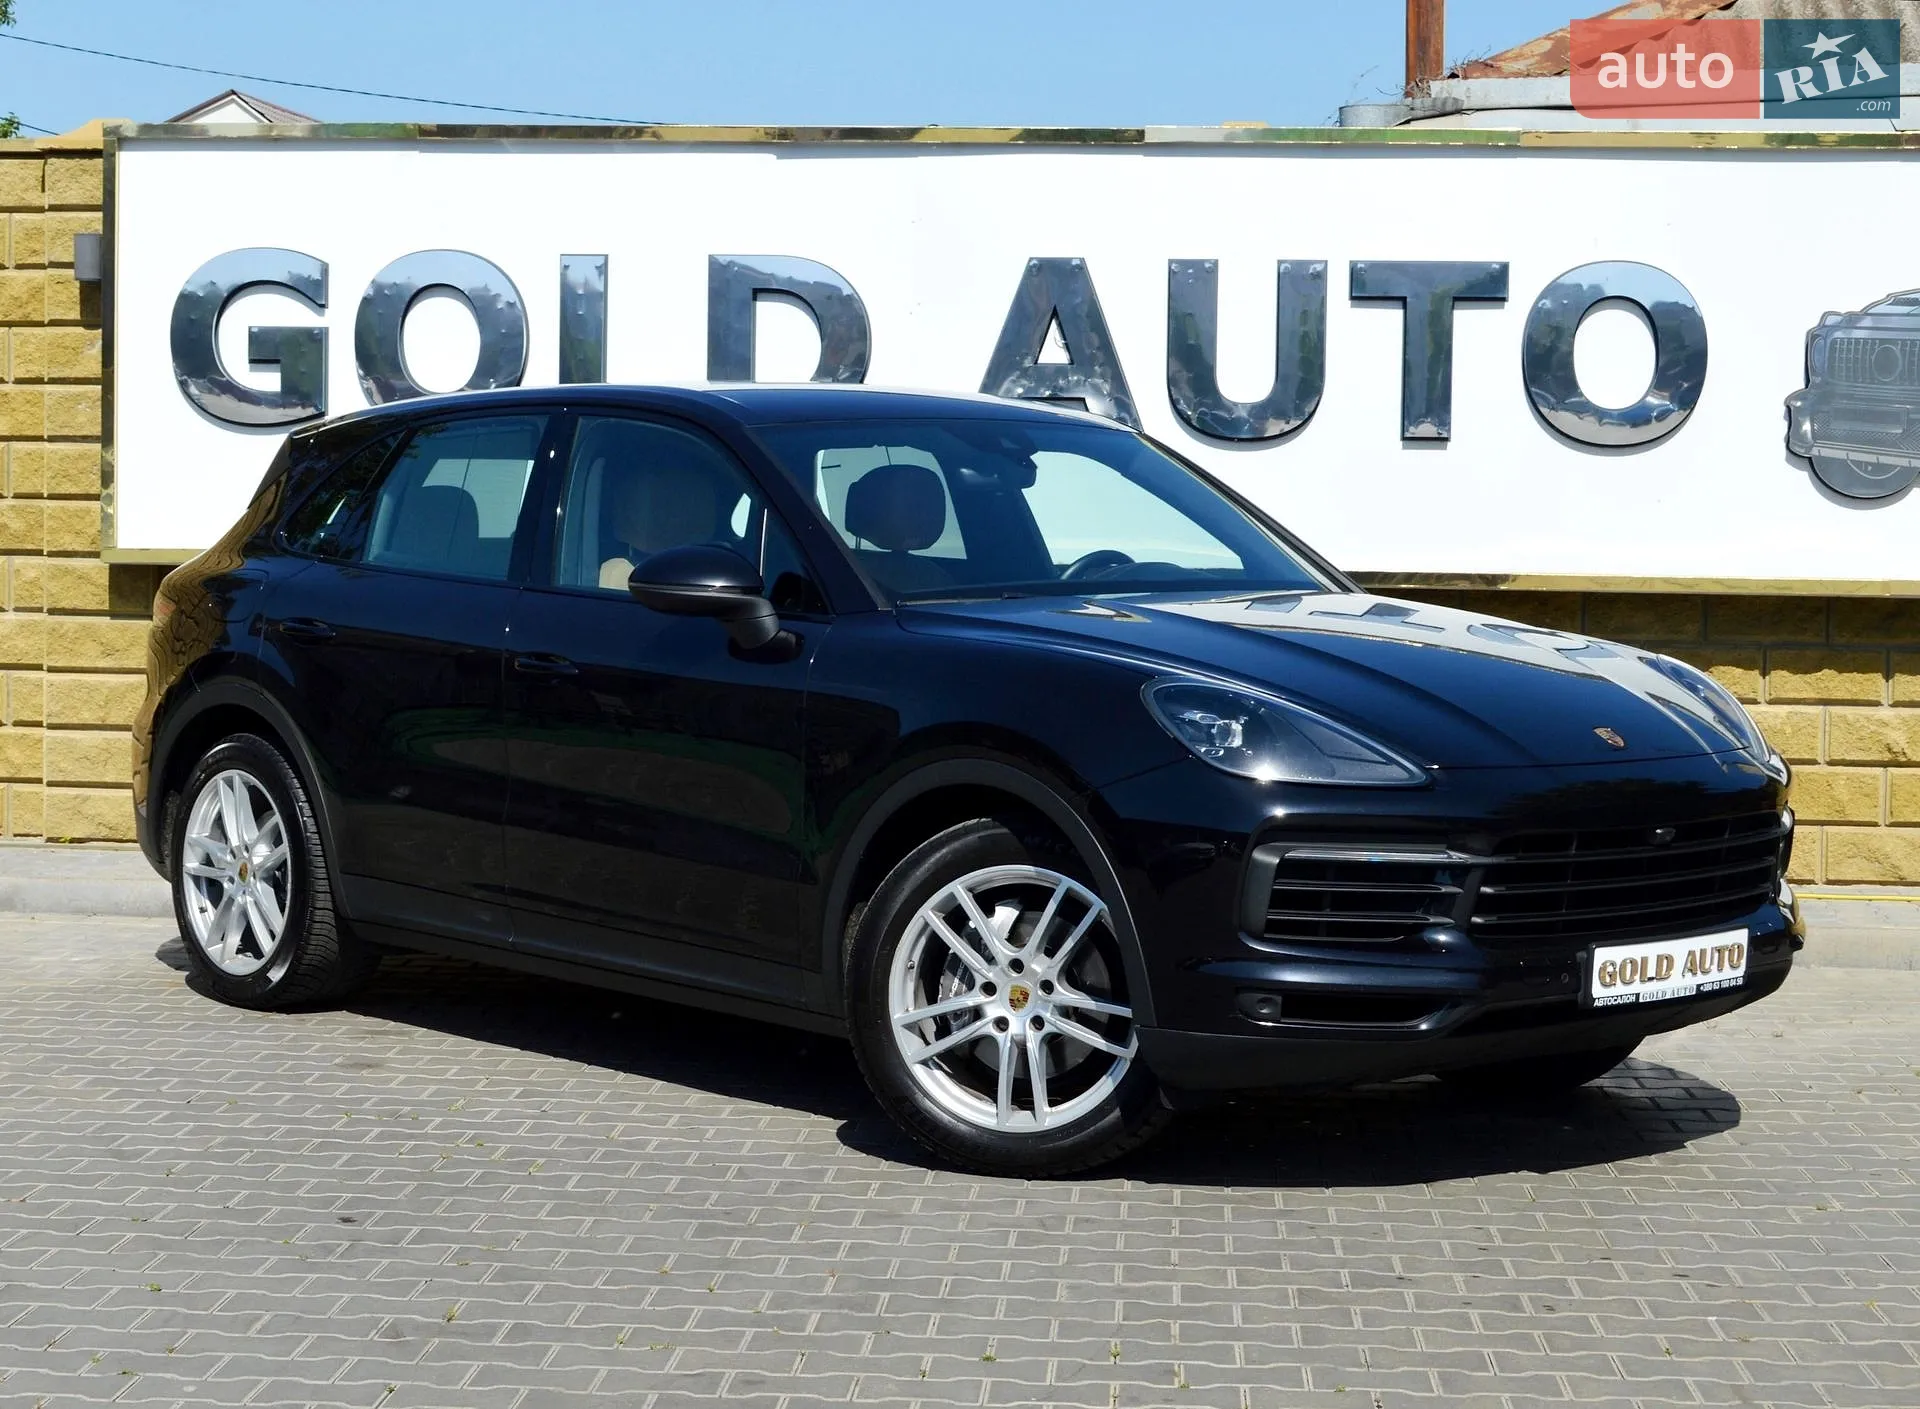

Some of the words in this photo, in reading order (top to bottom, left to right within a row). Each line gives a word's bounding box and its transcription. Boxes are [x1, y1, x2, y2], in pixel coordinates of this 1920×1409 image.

[978, 256, 1708, 446] AUTO
[1598, 953, 1675, 987] GOLD
[1682, 942, 1745, 977] AUTO
[1593, 994, 1637, 1007] АВТОСАЛОН
[1642, 991, 1667, 1001] GOLD
[1671, 986, 1695, 997] AUTO
